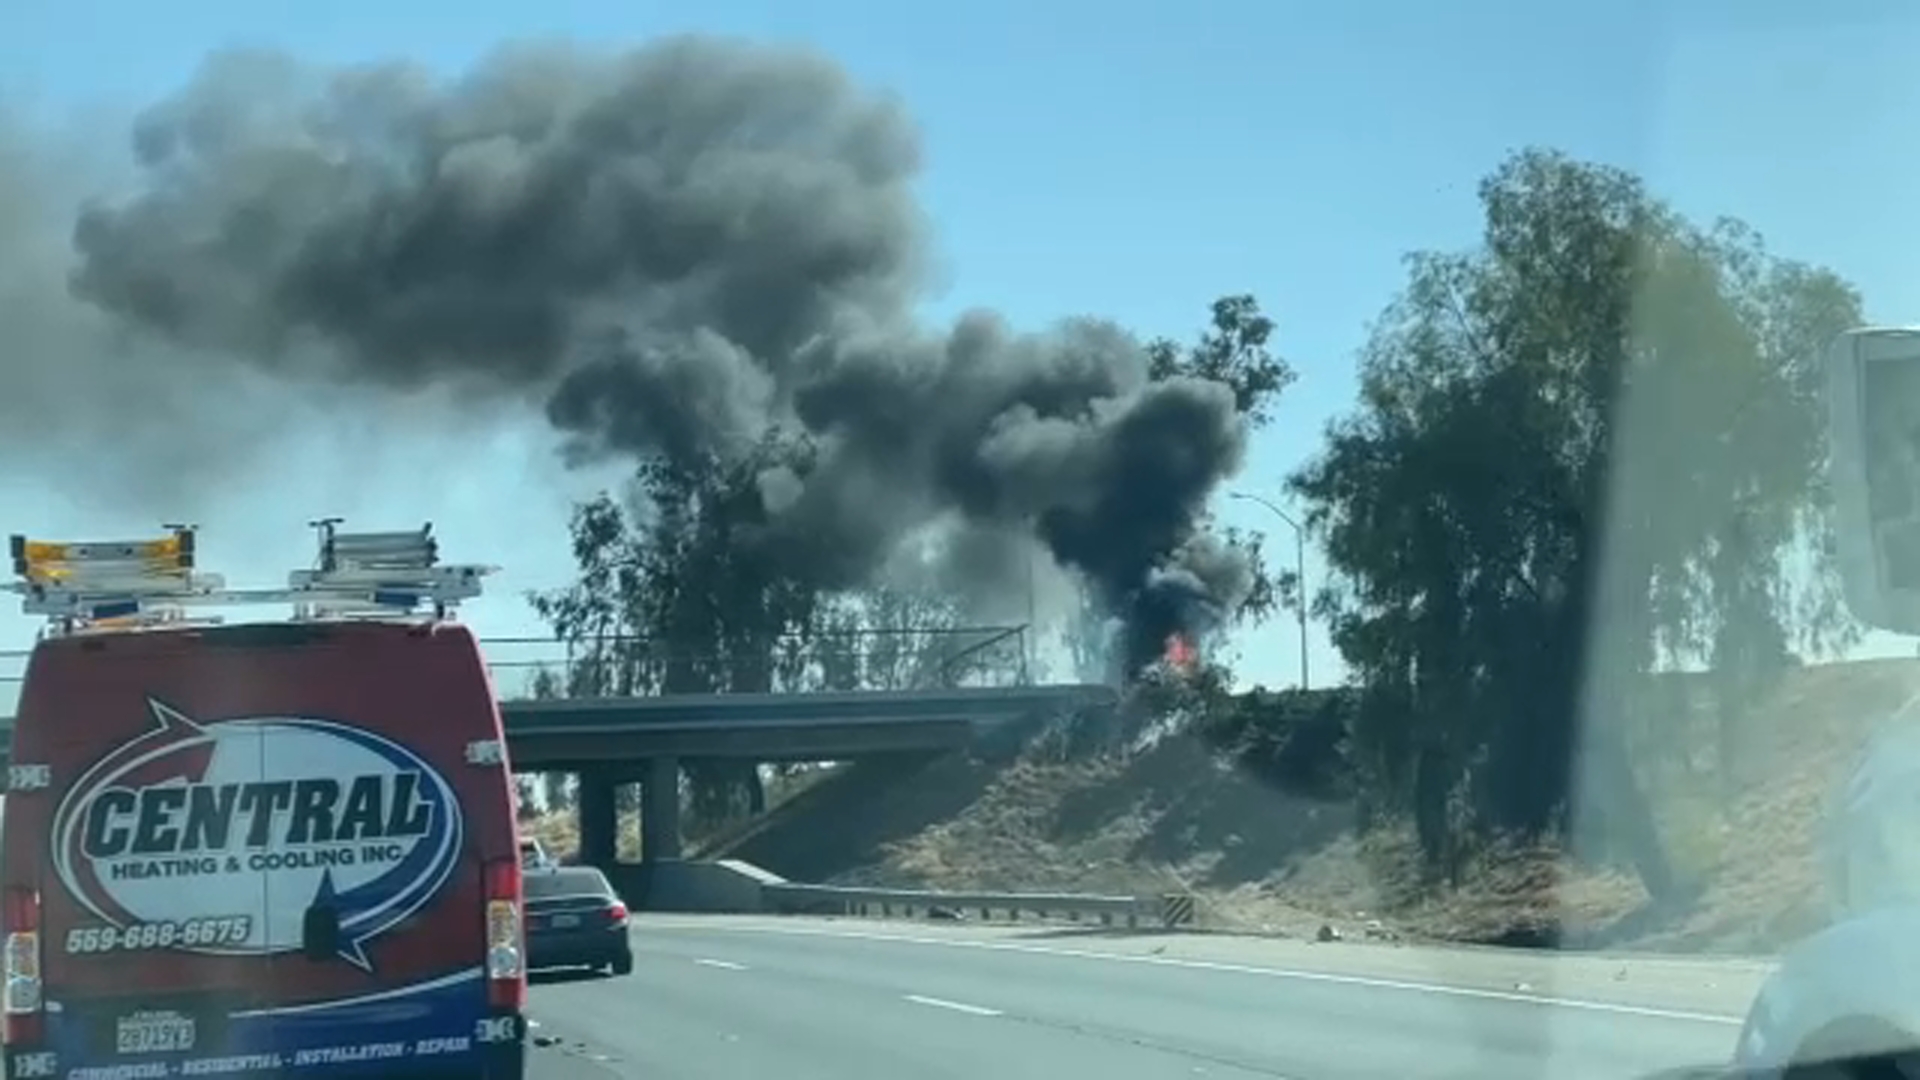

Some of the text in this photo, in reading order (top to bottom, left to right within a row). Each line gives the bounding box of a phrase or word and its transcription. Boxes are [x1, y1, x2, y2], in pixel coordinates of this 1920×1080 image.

[82, 770, 432, 859] CENTRAL
[111, 857, 218, 880] HEATING
[226, 855, 241, 873] &
[248, 846, 355, 872] COOLING
[66, 916, 250, 953] 559-688-6675
[67, 1062, 169, 1080] COMMERCIAL
[181, 1053, 282, 1076] RESIDENTIAL
[294, 1041, 404, 1067] INSTALLATION
[414, 1036, 471, 1055] REPAIR
